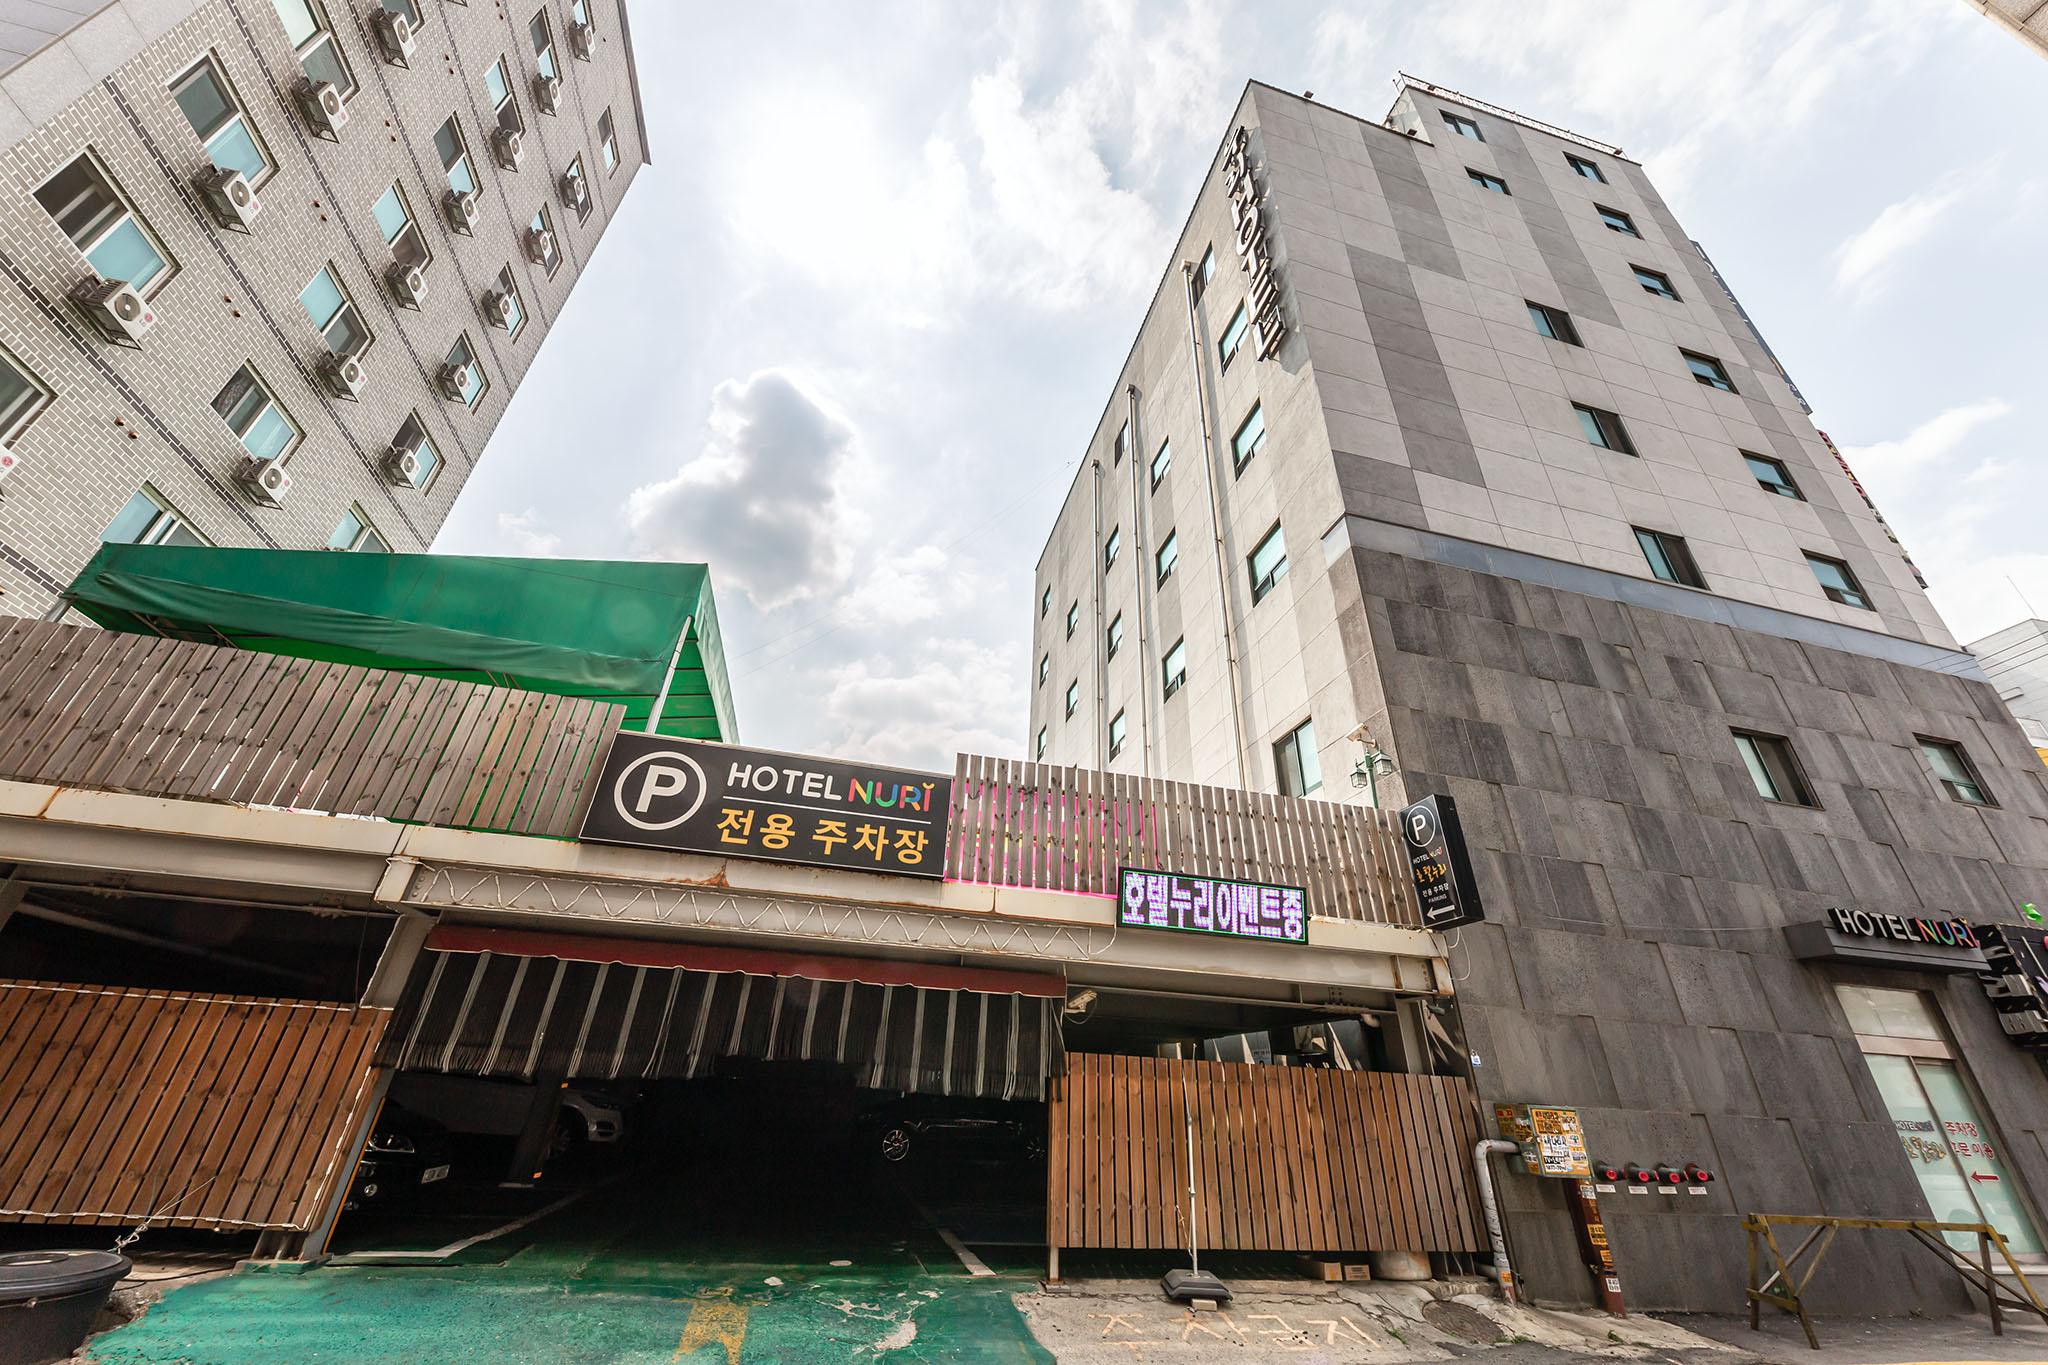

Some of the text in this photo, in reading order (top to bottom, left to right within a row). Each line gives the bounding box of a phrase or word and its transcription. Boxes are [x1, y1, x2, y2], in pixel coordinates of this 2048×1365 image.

[1231, 168, 1288, 361] HOTEL
[635, 763, 688, 814] P
[726, 762, 842, 801] HOTEL
[715, 807, 929, 865] 전용 주차장
[1411, 813, 1427, 842] P
[1412, 853, 1430, 864] HOTEL
[1832, 907, 1922, 943] HOTEL
